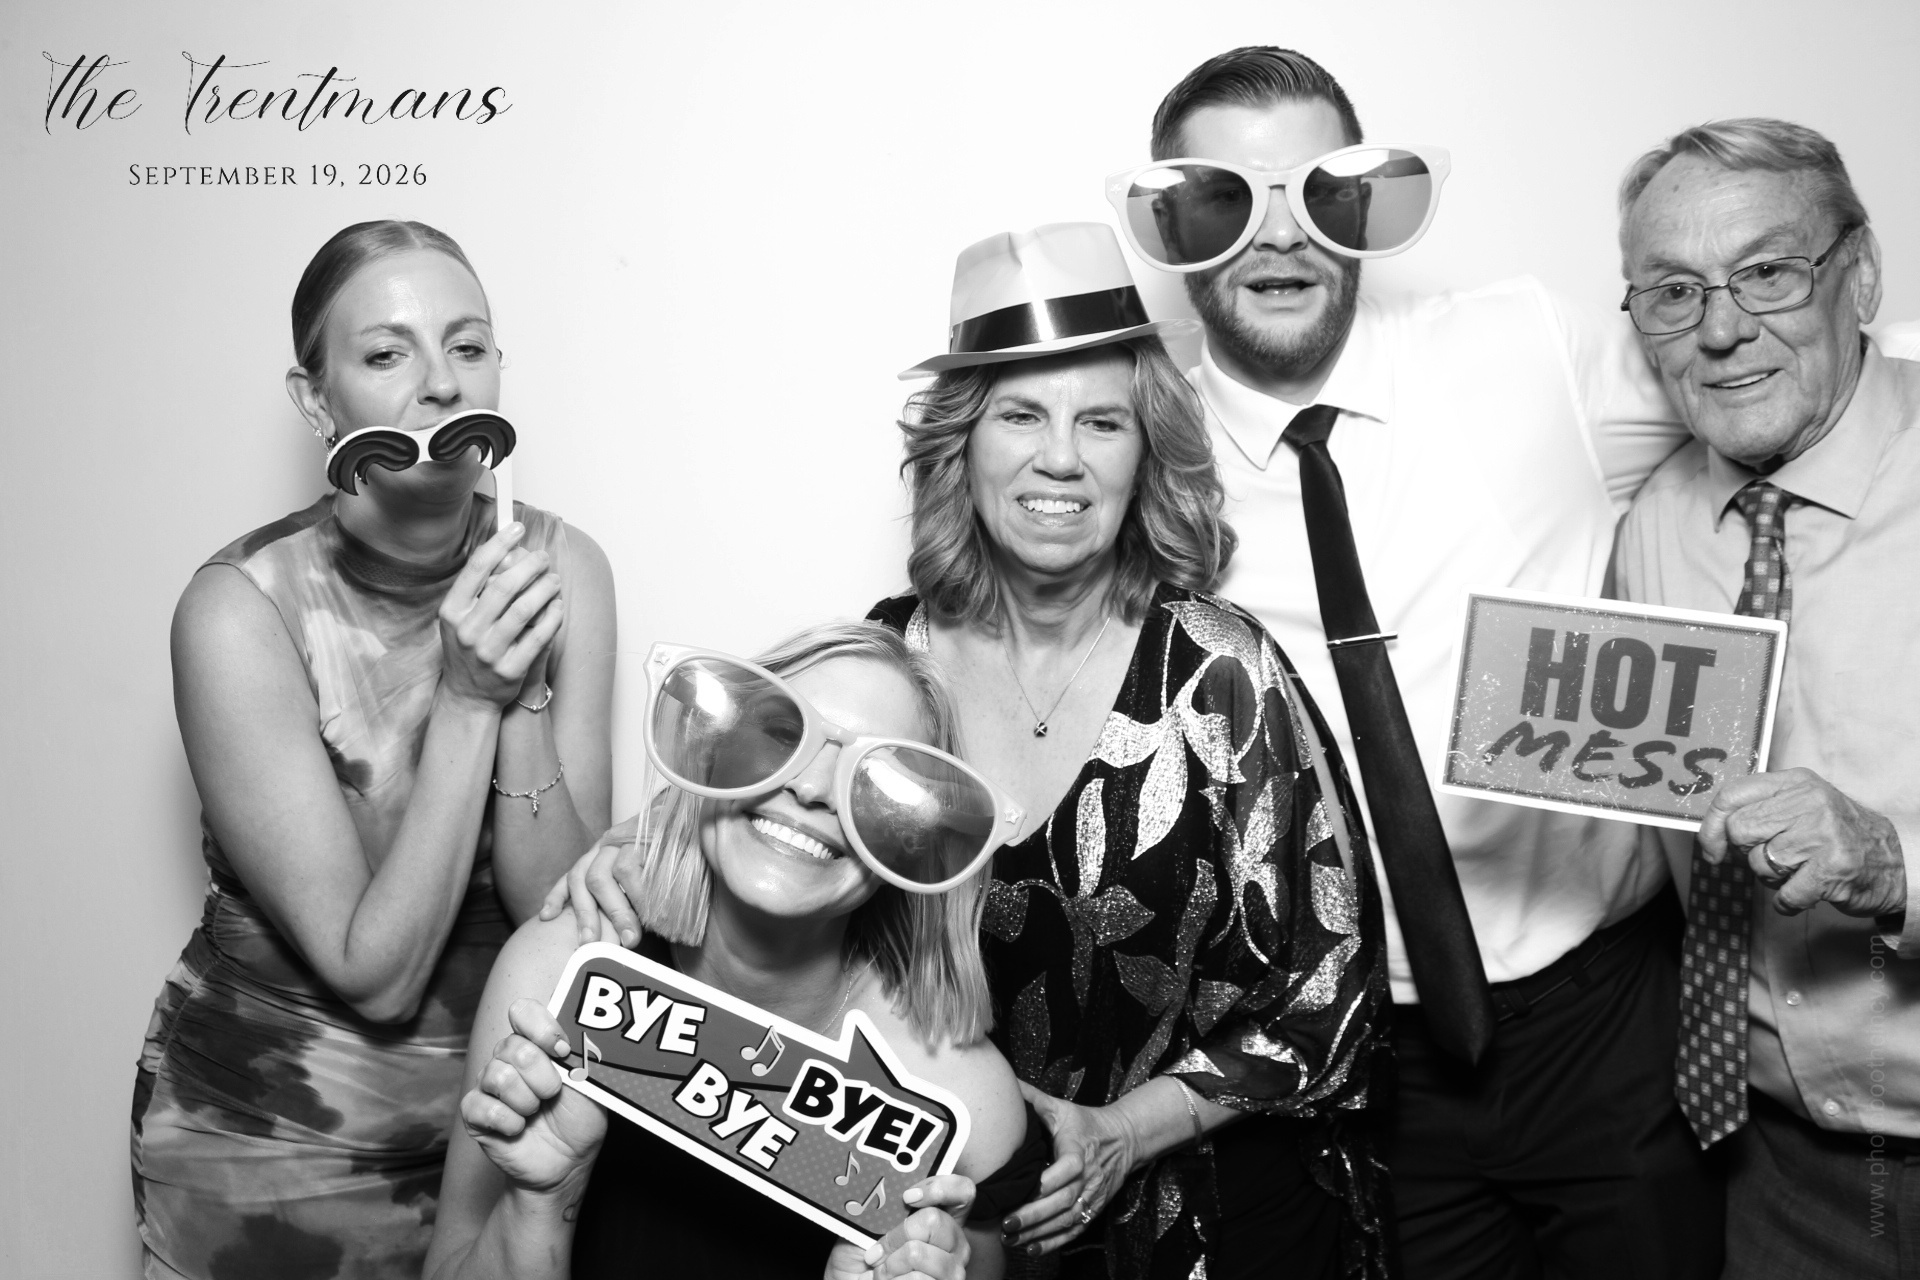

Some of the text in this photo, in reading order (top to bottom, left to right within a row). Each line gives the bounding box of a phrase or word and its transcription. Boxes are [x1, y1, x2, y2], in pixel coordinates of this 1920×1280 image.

[1519, 626, 1718, 738] HOT
[1481, 720, 1728, 796] MESS
[576, 973, 706, 1055] BYE
[674, 1061, 797, 1170] BYE
[789, 1065, 937, 1166] BYE!
